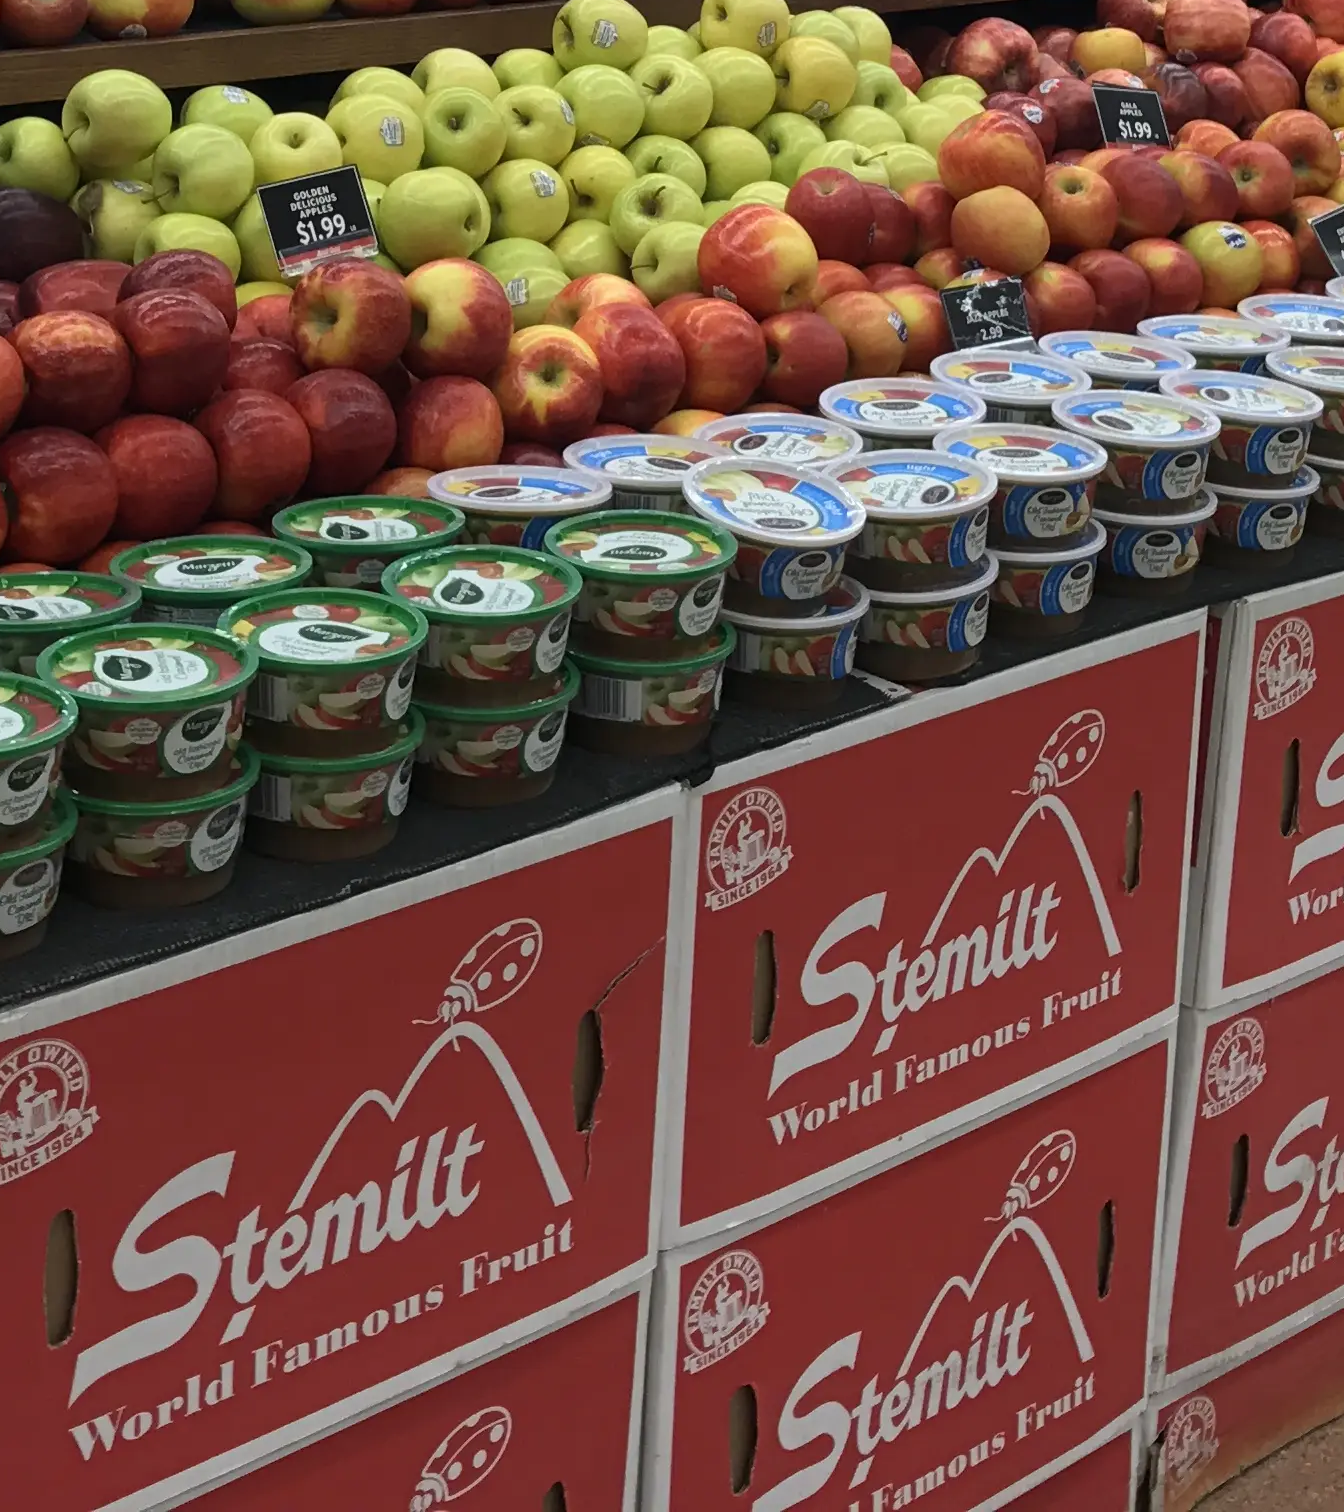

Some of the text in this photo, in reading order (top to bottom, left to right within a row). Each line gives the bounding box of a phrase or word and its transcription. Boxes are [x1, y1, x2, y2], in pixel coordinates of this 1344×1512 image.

[1118, 120, 1152, 140] $1.99
[290, 193, 337, 211] DELICIOUS
[293, 185, 329, 201] GOLDEN
[299, 204, 334, 219] APPLES
[296, 213, 346, 246] $1.99
[980, 326, 1003, 340] 2.99
[708, 786, 786, 866] FAMILY OWNED
[716, 869, 782, 910] SINCE 1964
[768, 882, 1061, 1100] Stemilt
[27, 1039, 88, 1095] OWNED
[768, 966, 1123, 1146] World Famous Fruit
[43, 1127, 88, 1162] 1964
[68, 1122, 485, 1408] Stemilt
[1233, 1250, 1316, 1308] World
[69, 1218, 575, 1461] World Famous Fruit
[751, 1299, 1035, 1512] Stemilt
[875, 1376, 1097, 1510] Famous Fruit
